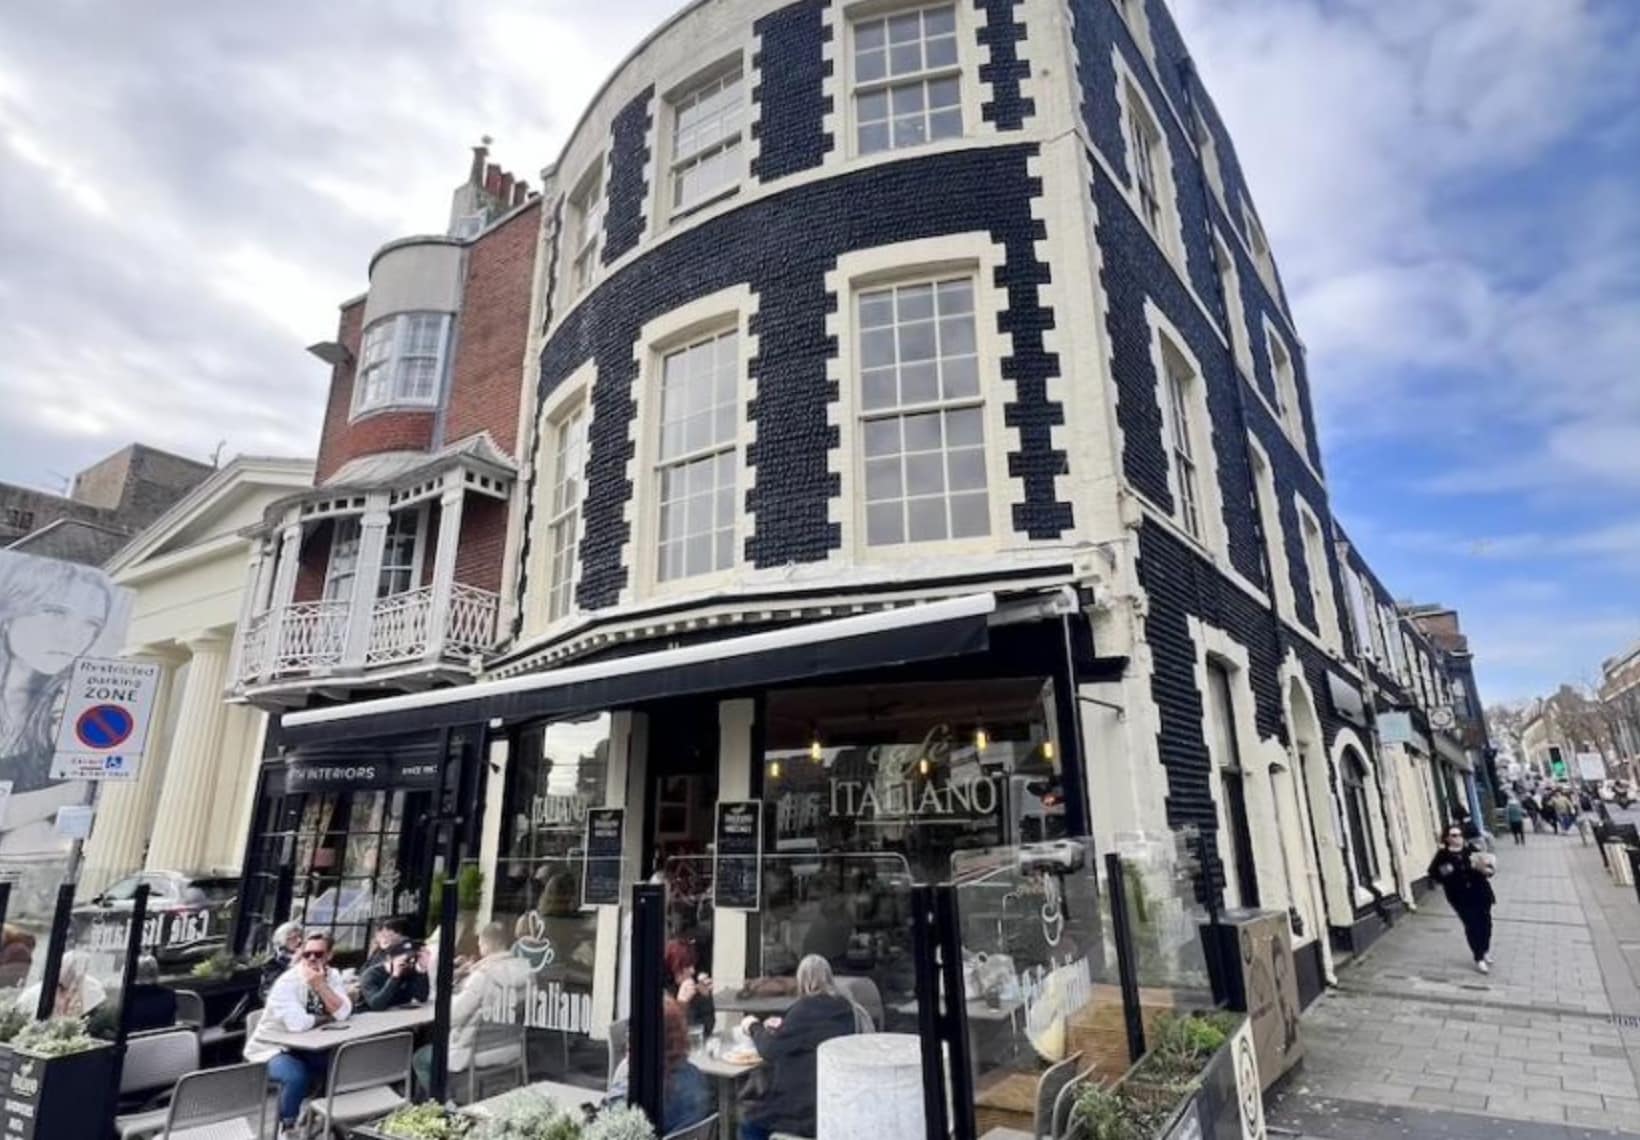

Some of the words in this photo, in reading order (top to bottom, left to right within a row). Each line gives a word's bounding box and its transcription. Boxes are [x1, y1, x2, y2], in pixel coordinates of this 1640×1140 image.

[80, 661, 155, 677] Restricted
[87, 676, 143, 689] parking
[84, 686, 138, 703] ZONE
[307, 766, 376, 781] INTERIORS
[828, 775, 998, 817] ITALIANO
[523, 979, 592, 1034] Italiano
